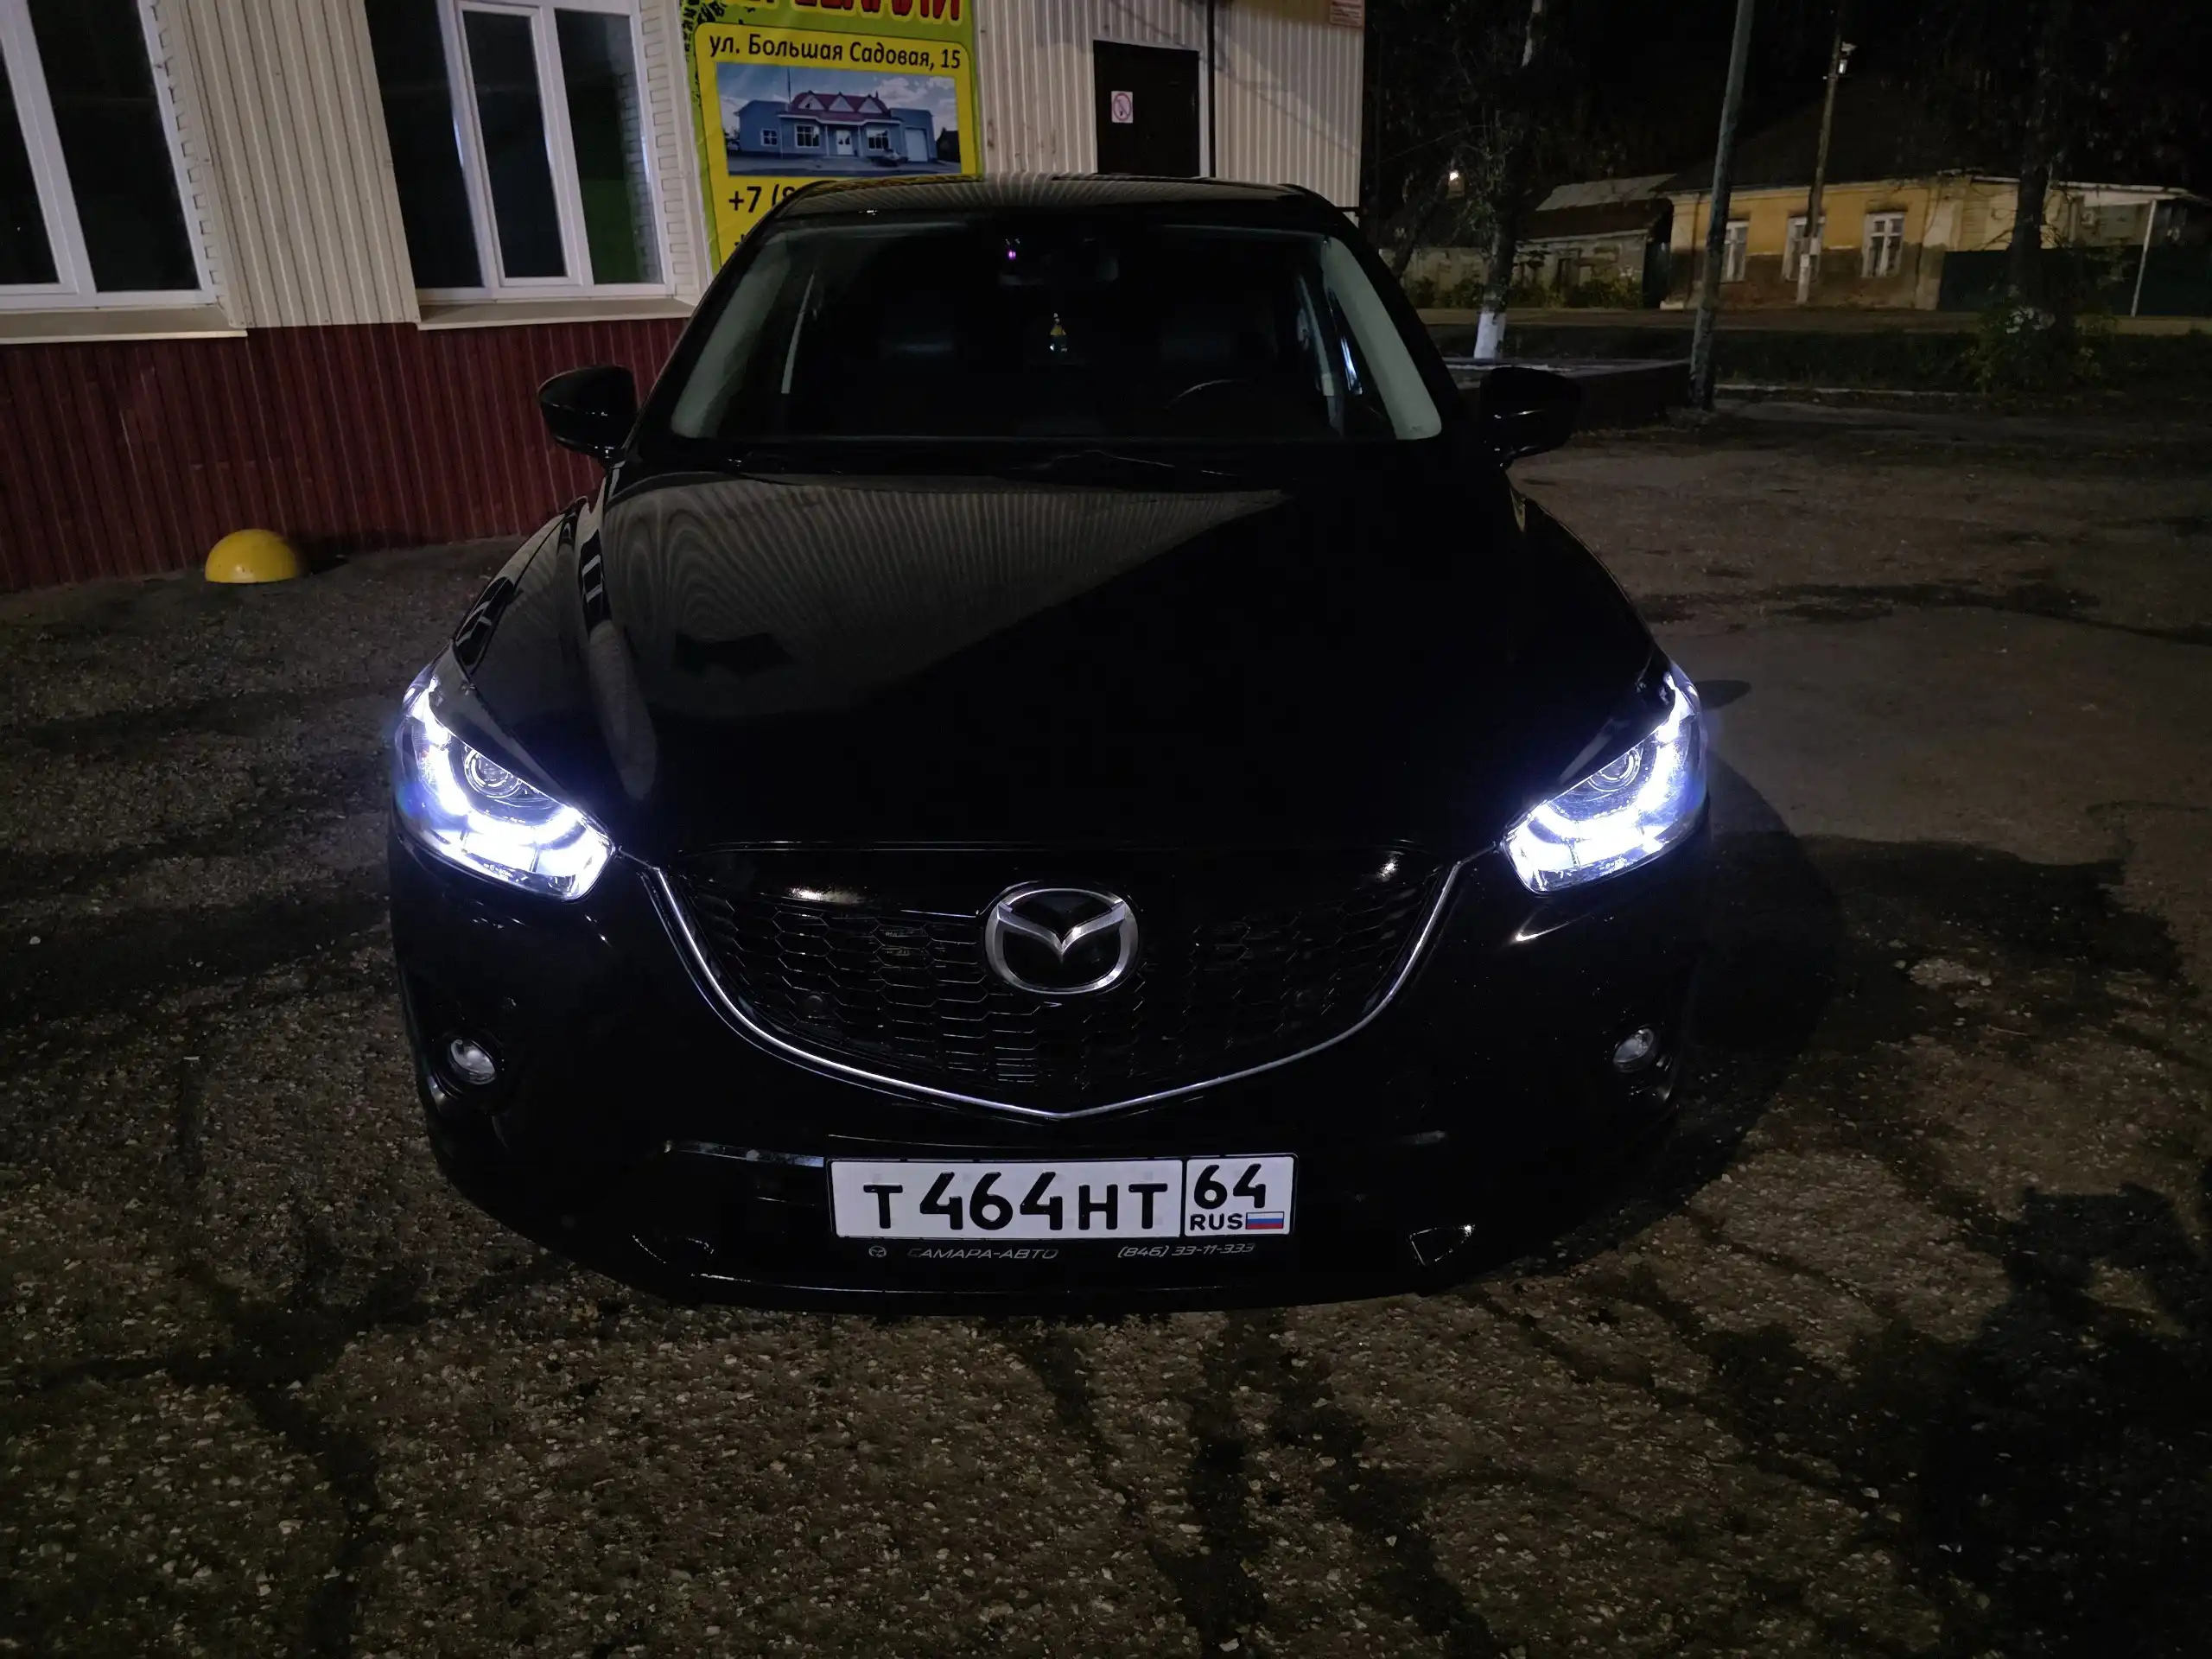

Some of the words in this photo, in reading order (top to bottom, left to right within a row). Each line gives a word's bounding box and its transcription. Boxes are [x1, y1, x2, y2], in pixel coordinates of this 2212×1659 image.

[709, 35, 741, 58] ул.
[747, 34, 842, 60] Большая
[849, 41, 934, 71] Садовая,
[940, 49, 961, 69] 15
[728, 186, 762, 213] +7
[1193, 1163, 1267, 1210] 64
[1189, 1212, 1243, 1230] RUS
[906, 1248, 1059, 1260] САМАРА-АВТО
[1117, 1245, 1169, 1258] (846)
[1171, 1243, 1256, 1256] 33-11-333
